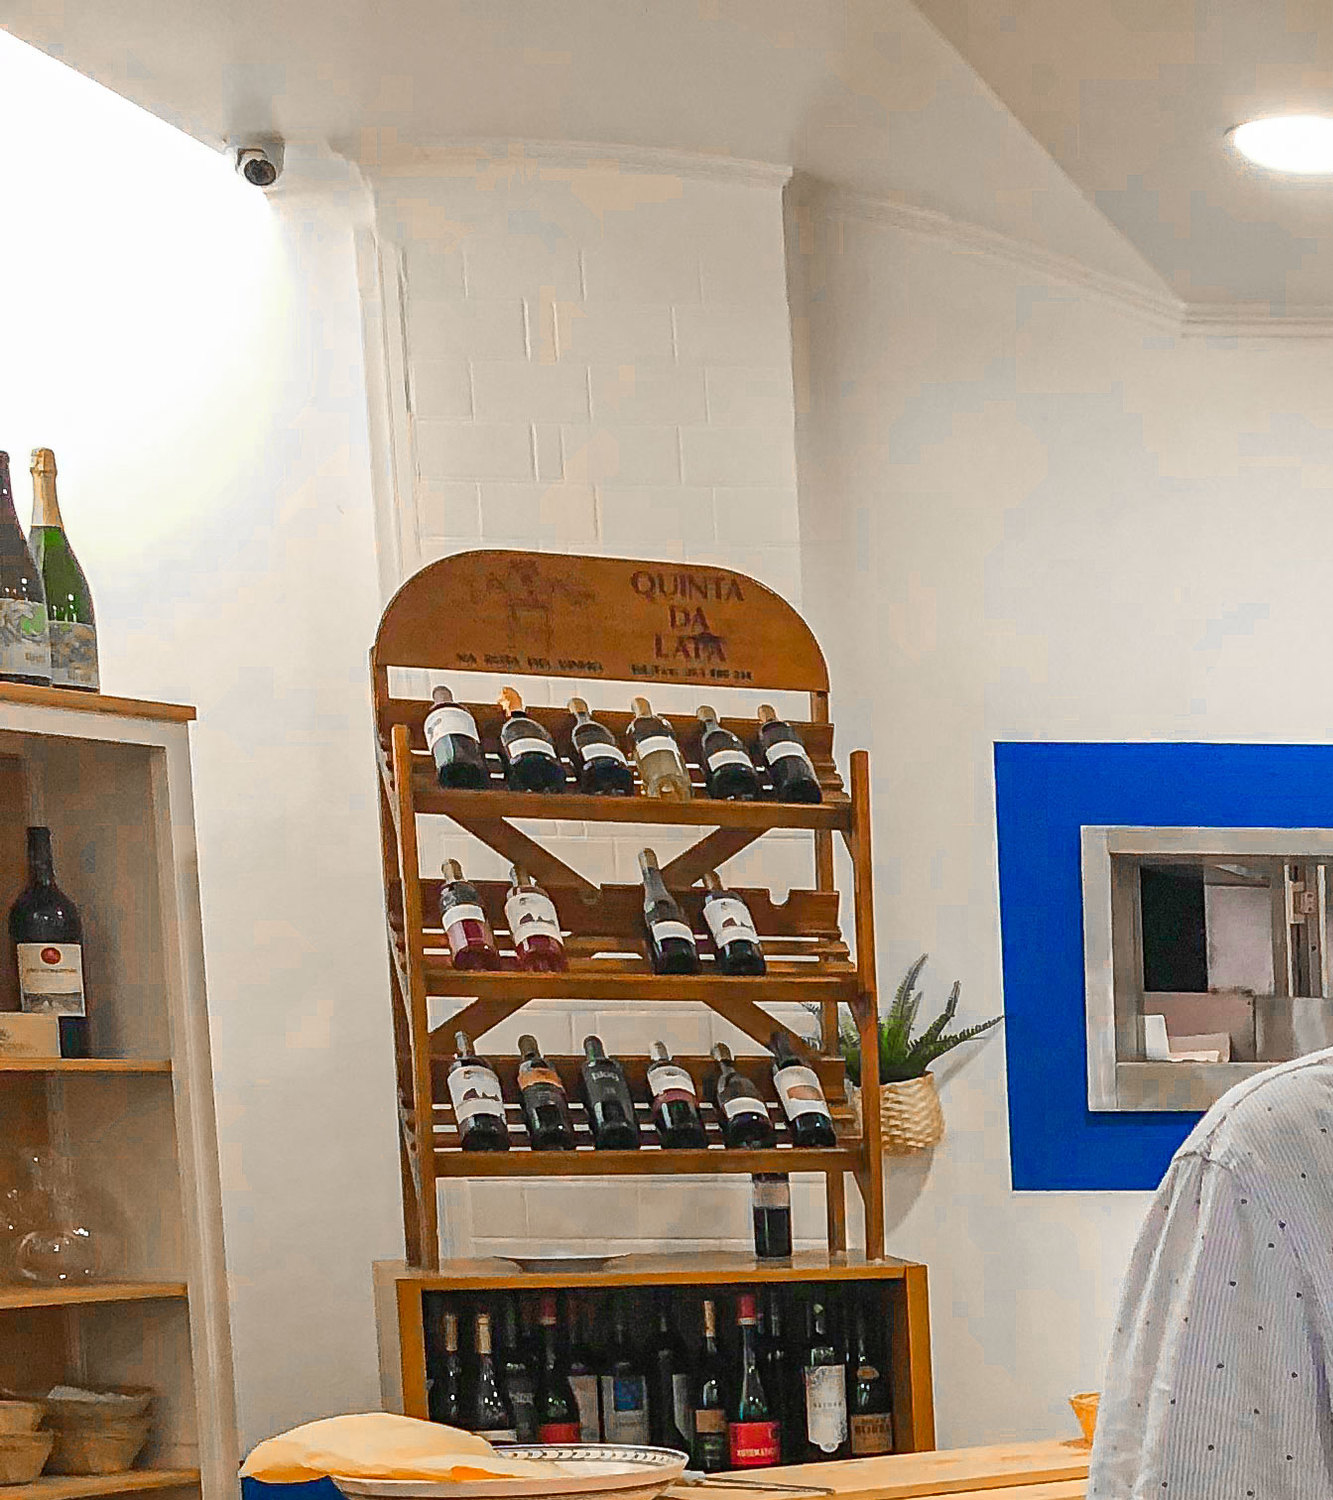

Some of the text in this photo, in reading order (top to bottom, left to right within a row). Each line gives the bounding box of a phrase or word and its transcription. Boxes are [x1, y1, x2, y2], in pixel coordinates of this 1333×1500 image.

[630, 570, 744, 603] QUINTA
[668, 604, 711, 632] DA
[654, 632, 727, 663] LATA
